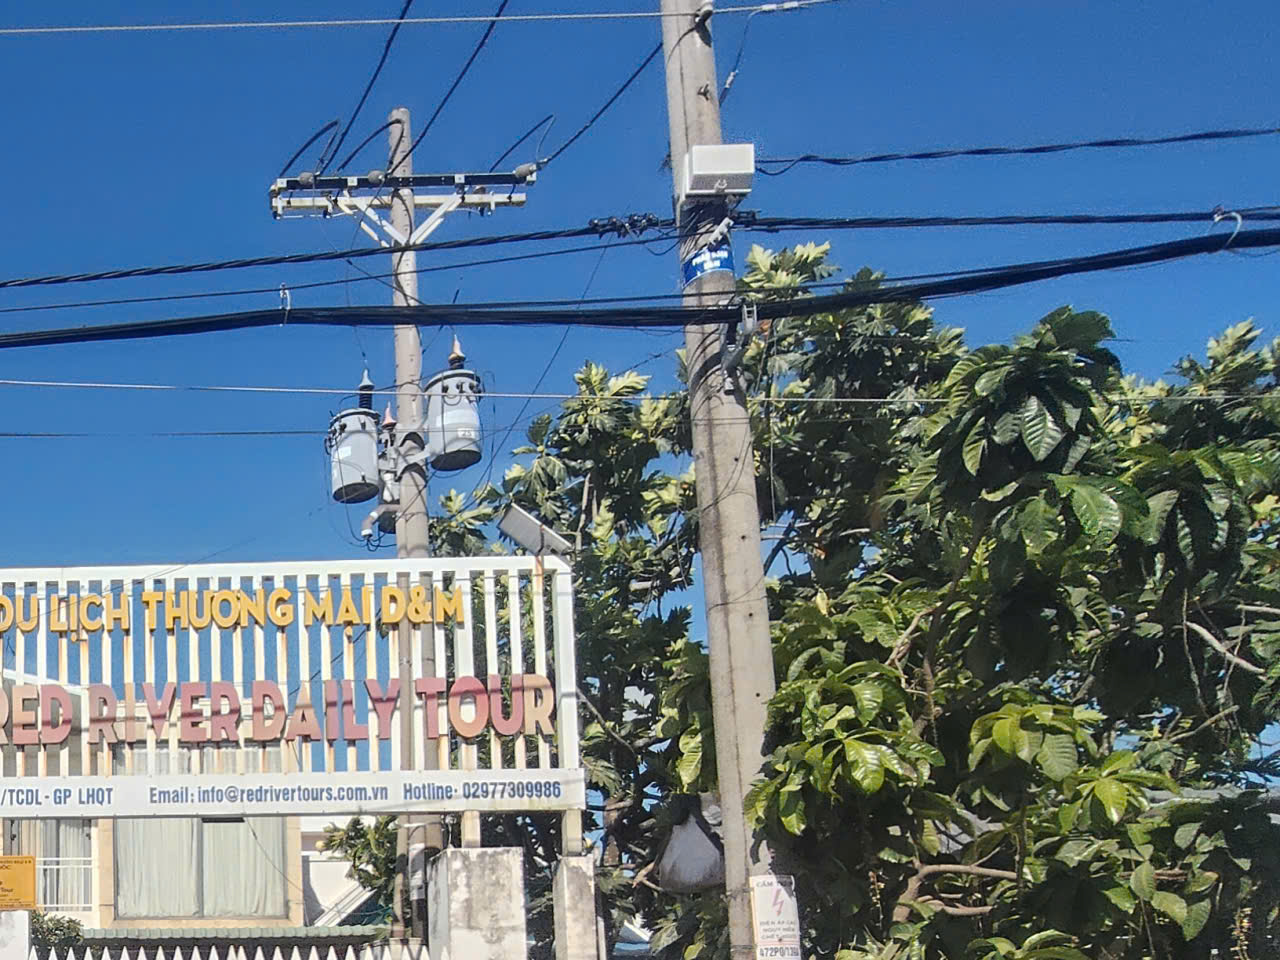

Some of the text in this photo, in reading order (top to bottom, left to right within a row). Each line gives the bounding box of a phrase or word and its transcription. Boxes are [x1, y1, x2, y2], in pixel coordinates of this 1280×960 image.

[49, 591, 129, 643] LỊCH
[303, 586, 370, 637] MẠI
[380, 584, 465, 625] D&M
[87, 681, 242, 746] RIVER
[252, 678, 401, 742] DAILY
[415, 673, 556, 739] TOUR
[78, 786, 114, 806] LHQT
[197, 784, 389, 804] info@redrivertours.com.vn
[462, 780, 562, 800] 02977309986
